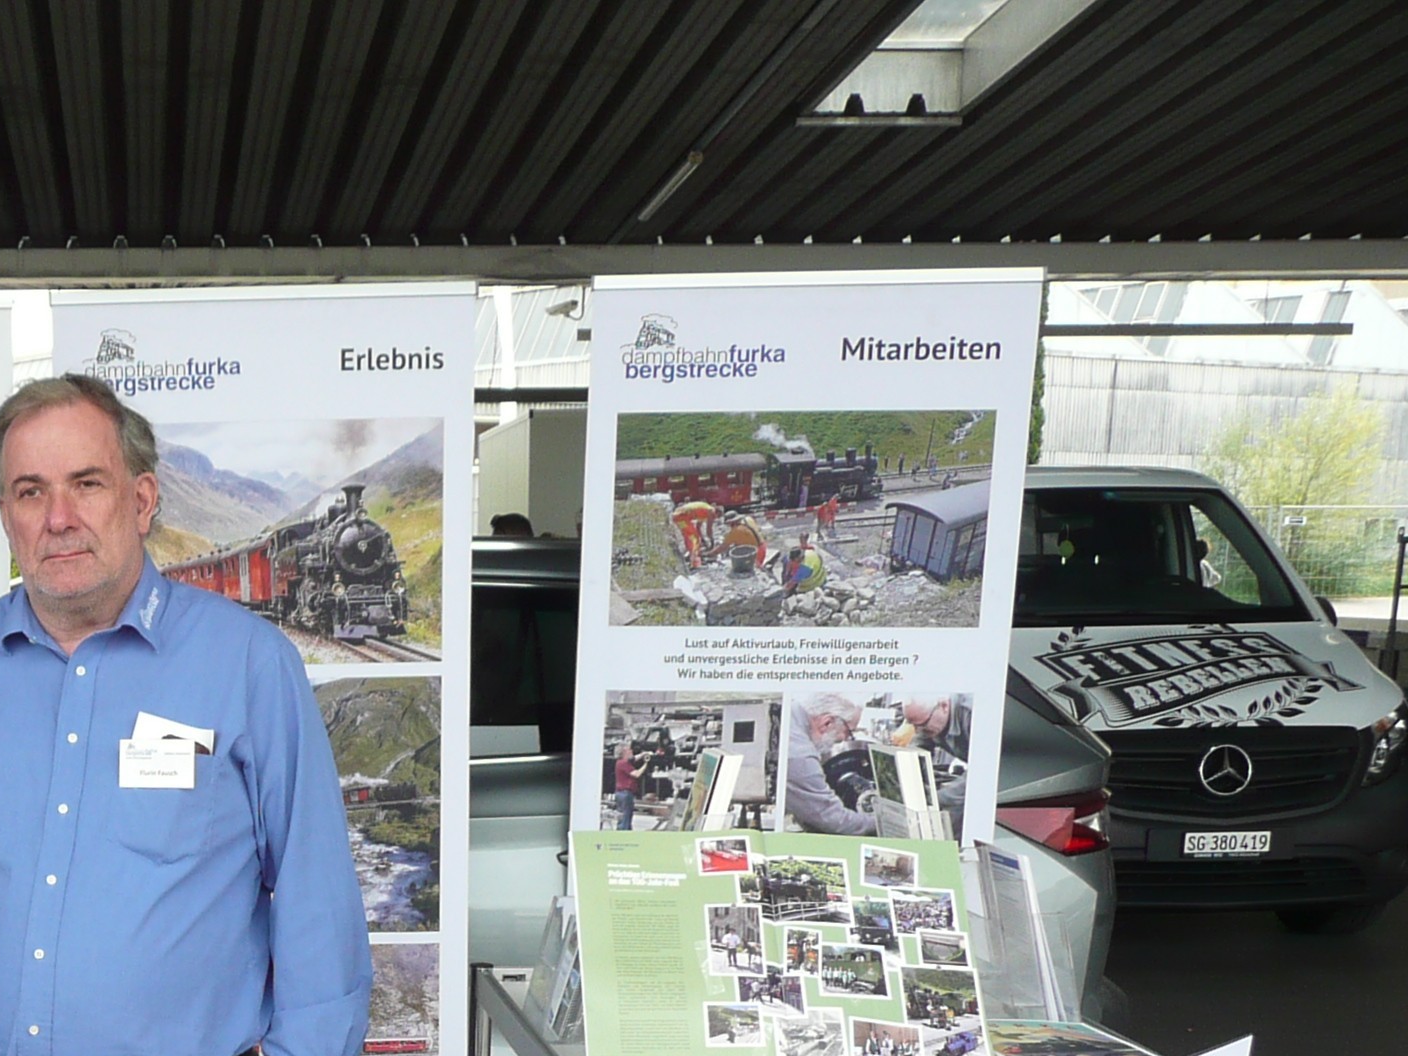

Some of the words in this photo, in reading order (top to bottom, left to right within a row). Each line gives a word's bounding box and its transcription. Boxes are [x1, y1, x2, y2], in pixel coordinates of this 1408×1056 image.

[340, 346, 445, 372] Erlebnis
[841, 337, 1002, 361] Mitarbeiten
[625, 362, 758, 383] bergstrecke
[104, 375, 216, 397] ergstrecke
[685, 638, 708, 649] Lust
[712, 638, 729, 649] auf
[732, 638, 797, 651] Aktivurlaub,
[800, 638, 899, 652] Freiwilligenarbeit
[664, 654, 684, 664] und
[687, 654, 769, 667] unvergessliche
[772, 654, 828, 665] Erlebnisse
[831, 654, 842, 665] in
[845, 654, 866, 665] den
[869, 654, 909, 667] Bergen
[1060, 638, 1282, 681] FITNESS
[677, 669, 696, 679] Wir
[699, 669, 733, 680] haben
[737, 669, 754, 680] die
[756, 669, 844, 683] entsprechenden
[847, 670, 903, 683] Angebote.
[1187, 835, 1206, 851] SG
[1210, 834, 1268, 850] 380419
